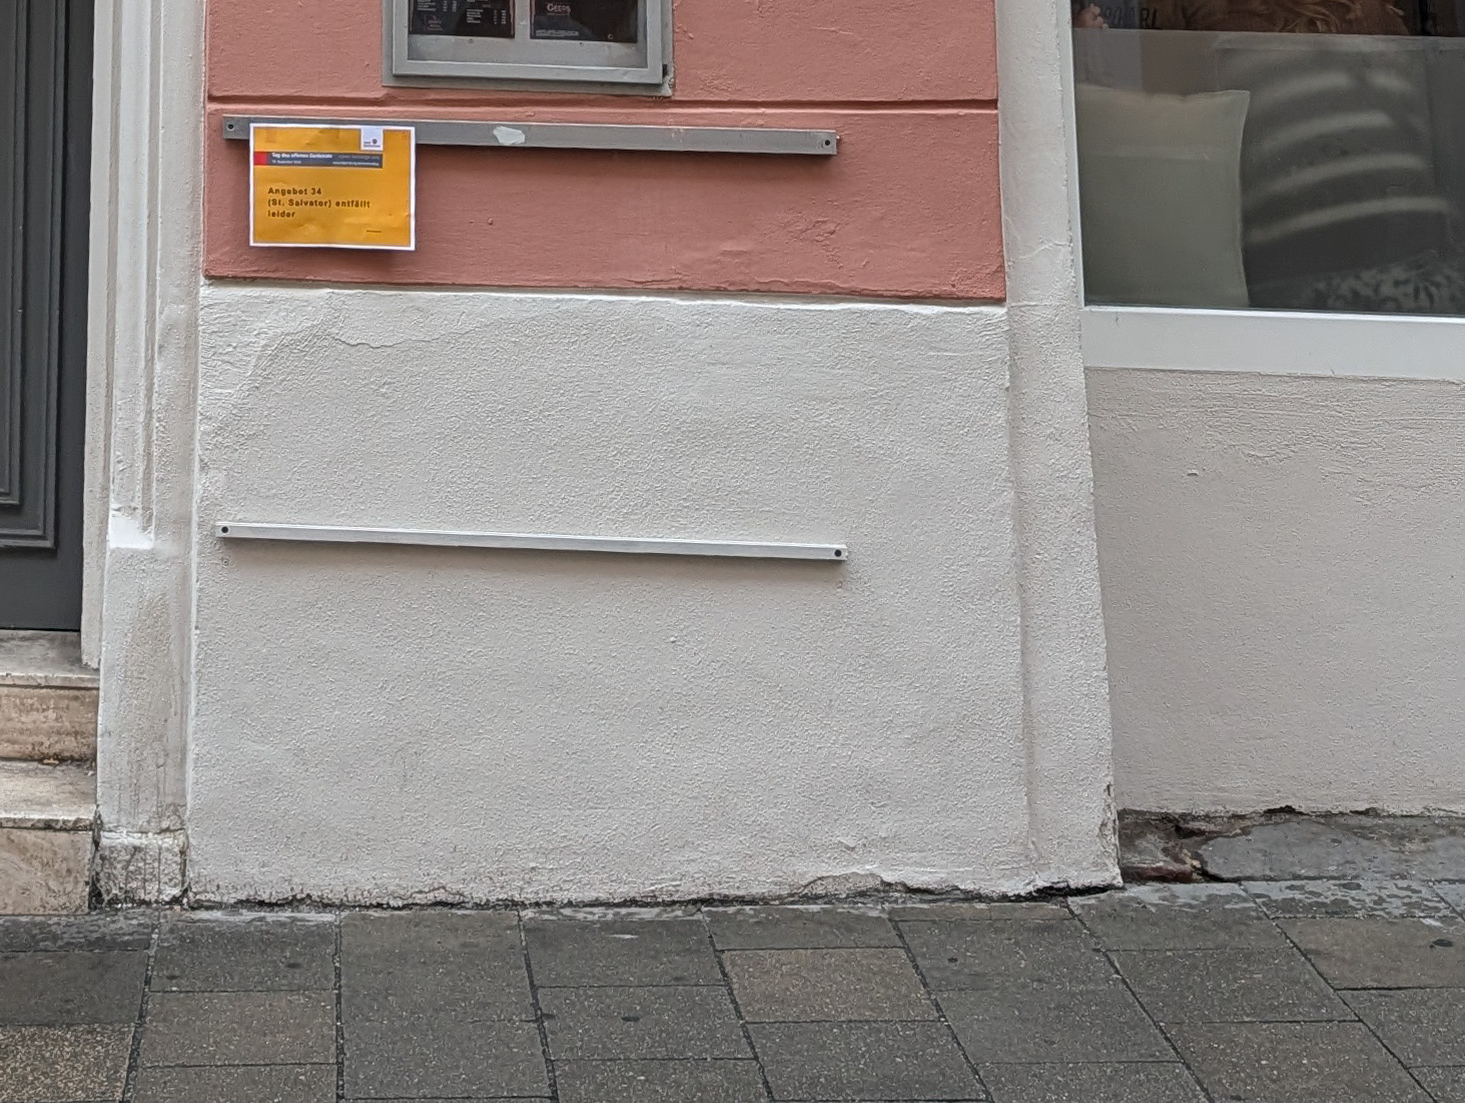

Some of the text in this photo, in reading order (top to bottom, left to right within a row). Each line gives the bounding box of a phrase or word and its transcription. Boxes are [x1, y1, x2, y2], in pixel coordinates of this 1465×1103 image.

[267, 187, 322, 196] Angebot 34
[267, 198, 370, 208] (St. Salvator) entfällt
[267, 210, 295, 218] leider
